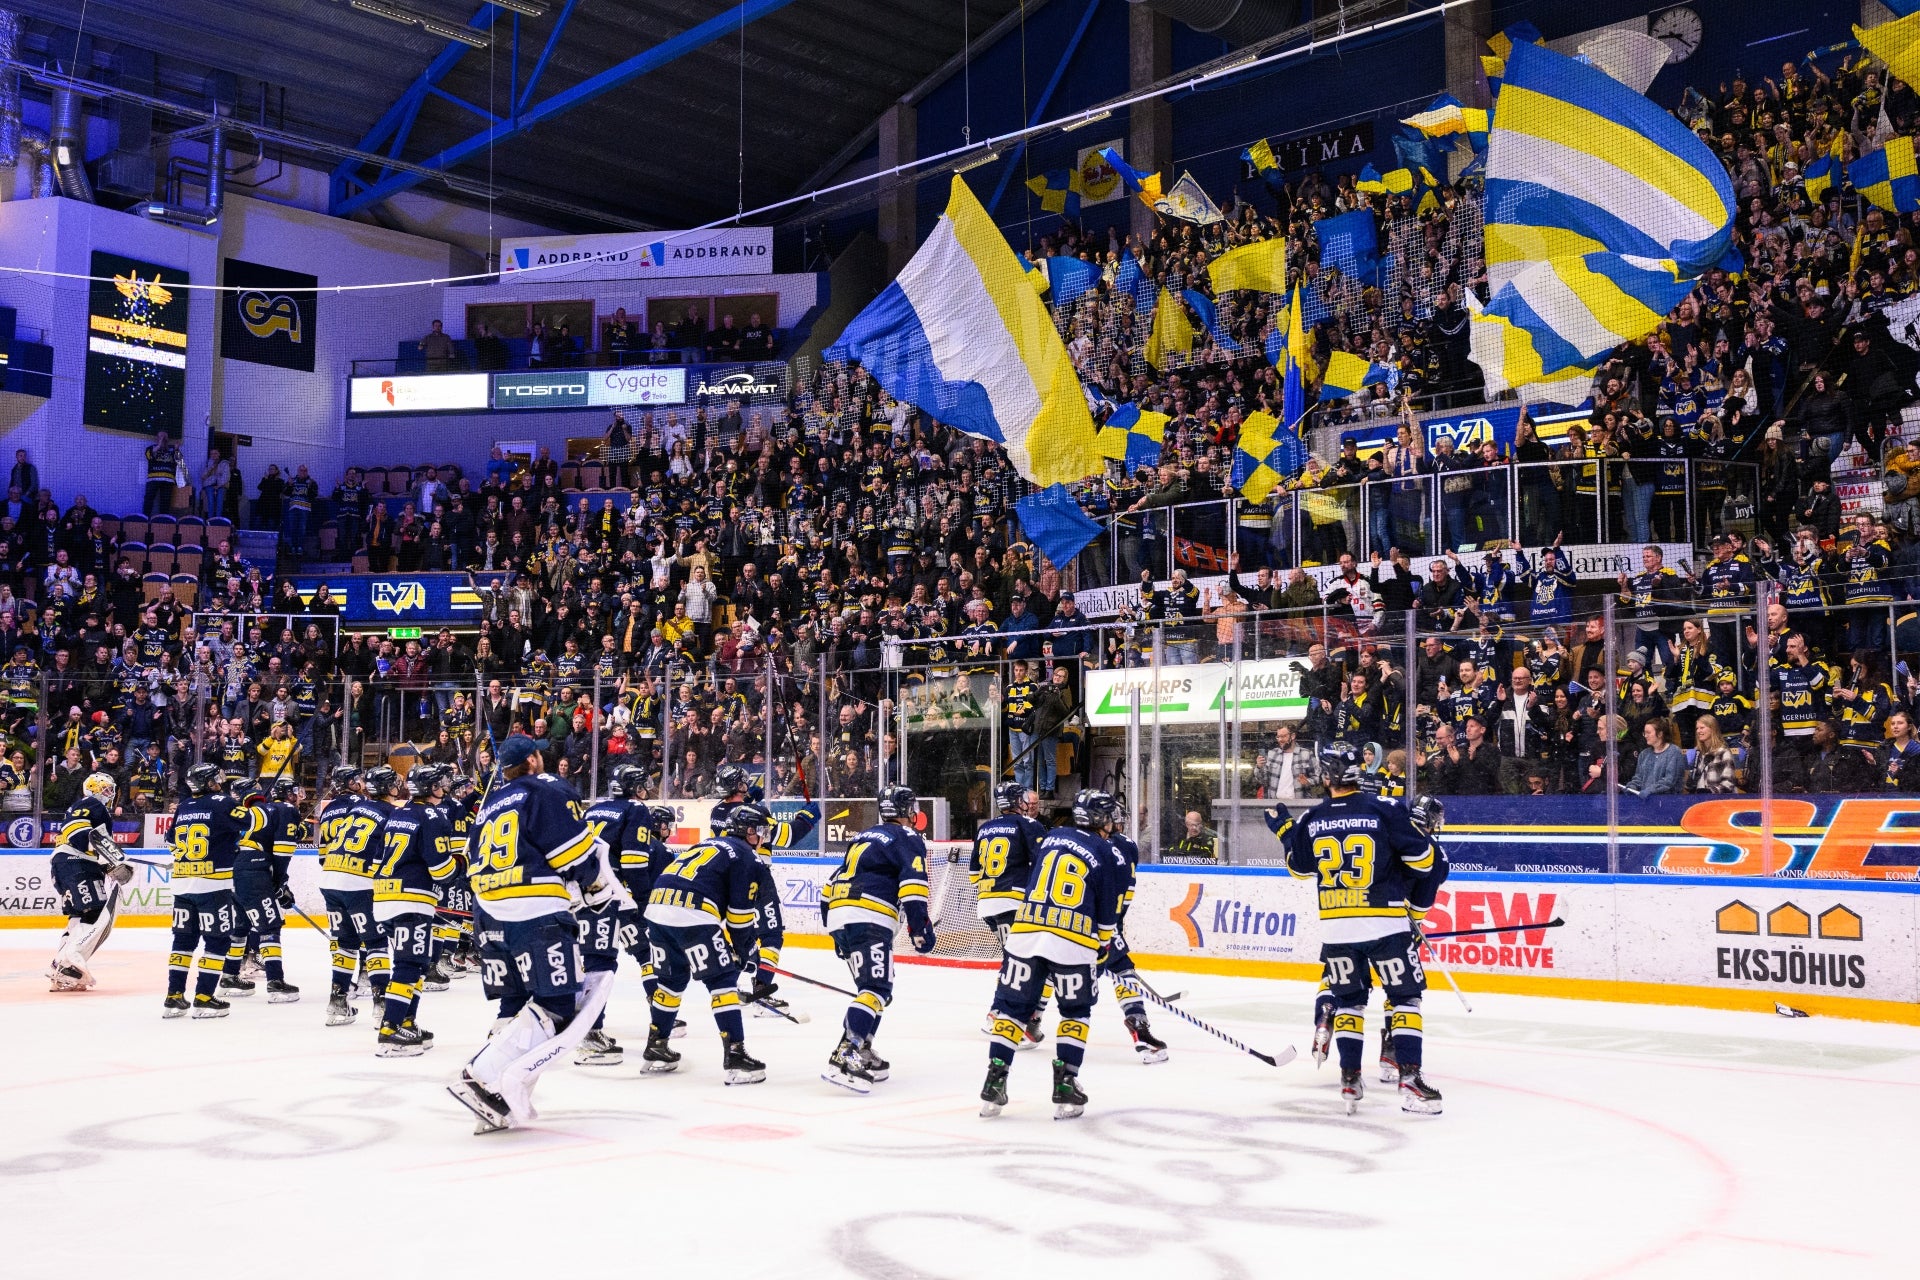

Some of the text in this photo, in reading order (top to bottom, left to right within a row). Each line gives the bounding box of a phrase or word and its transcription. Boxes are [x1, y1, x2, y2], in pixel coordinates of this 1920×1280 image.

[537, 250, 629, 265] ADDBRAND
[673, 245, 767, 259] ADDBRAND
[498, 384, 585, 396] TOSITO
[605, 373, 668, 393] Cygate
[1836, 485, 1870, 497] MAXI
[372, 582, 426, 615] HV71
[1848, 587, 1881, 595] AGERHULT
[1113, 678, 1192, 697] HAKARPS
[1227, 671, 1300, 692] HAKARP
[1245, 689, 1293, 700] EQUIPMENT
[1781, 712, 1817, 721] AGERHULT
[72, 808, 90, 817] 37
[484, 792, 527, 817] Husqvarna
[827, 824, 846, 842] EY
[1316, 818, 1378, 831] Husqvarna
[174, 823, 210, 861] 56
[466, 809, 520, 877] 39
[1047, 836, 1099, 868] Husqvarna
[1246, 858, 1287, 866] KONRADSS
[1313, 833, 1376, 890] 23
[1514, 863, 1583, 873] KONRADSSONS
[1642, 865, 1715, 875] KONRADSSONS
[1028, 849, 1090, 909] 16
[1775, 869, 1849, 879] KONRADSSONS
[1212, 899, 1297, 937] Kitron
[1420, 889, 1557, 946] SEW
[684, 943, 709, 974] JP
[1420, 943, 1554, 969] EURODRIVE
[1716, 944, 1866, 989] EKSJÖHUS
[483, 958, 508, 987] JP
[1001, 956, 1032, 991] JP
[1326, 956, 1355, 985] JP
[1376, 957, 1406, 986] JP
[1054, 972, 1084, 1000] JP
